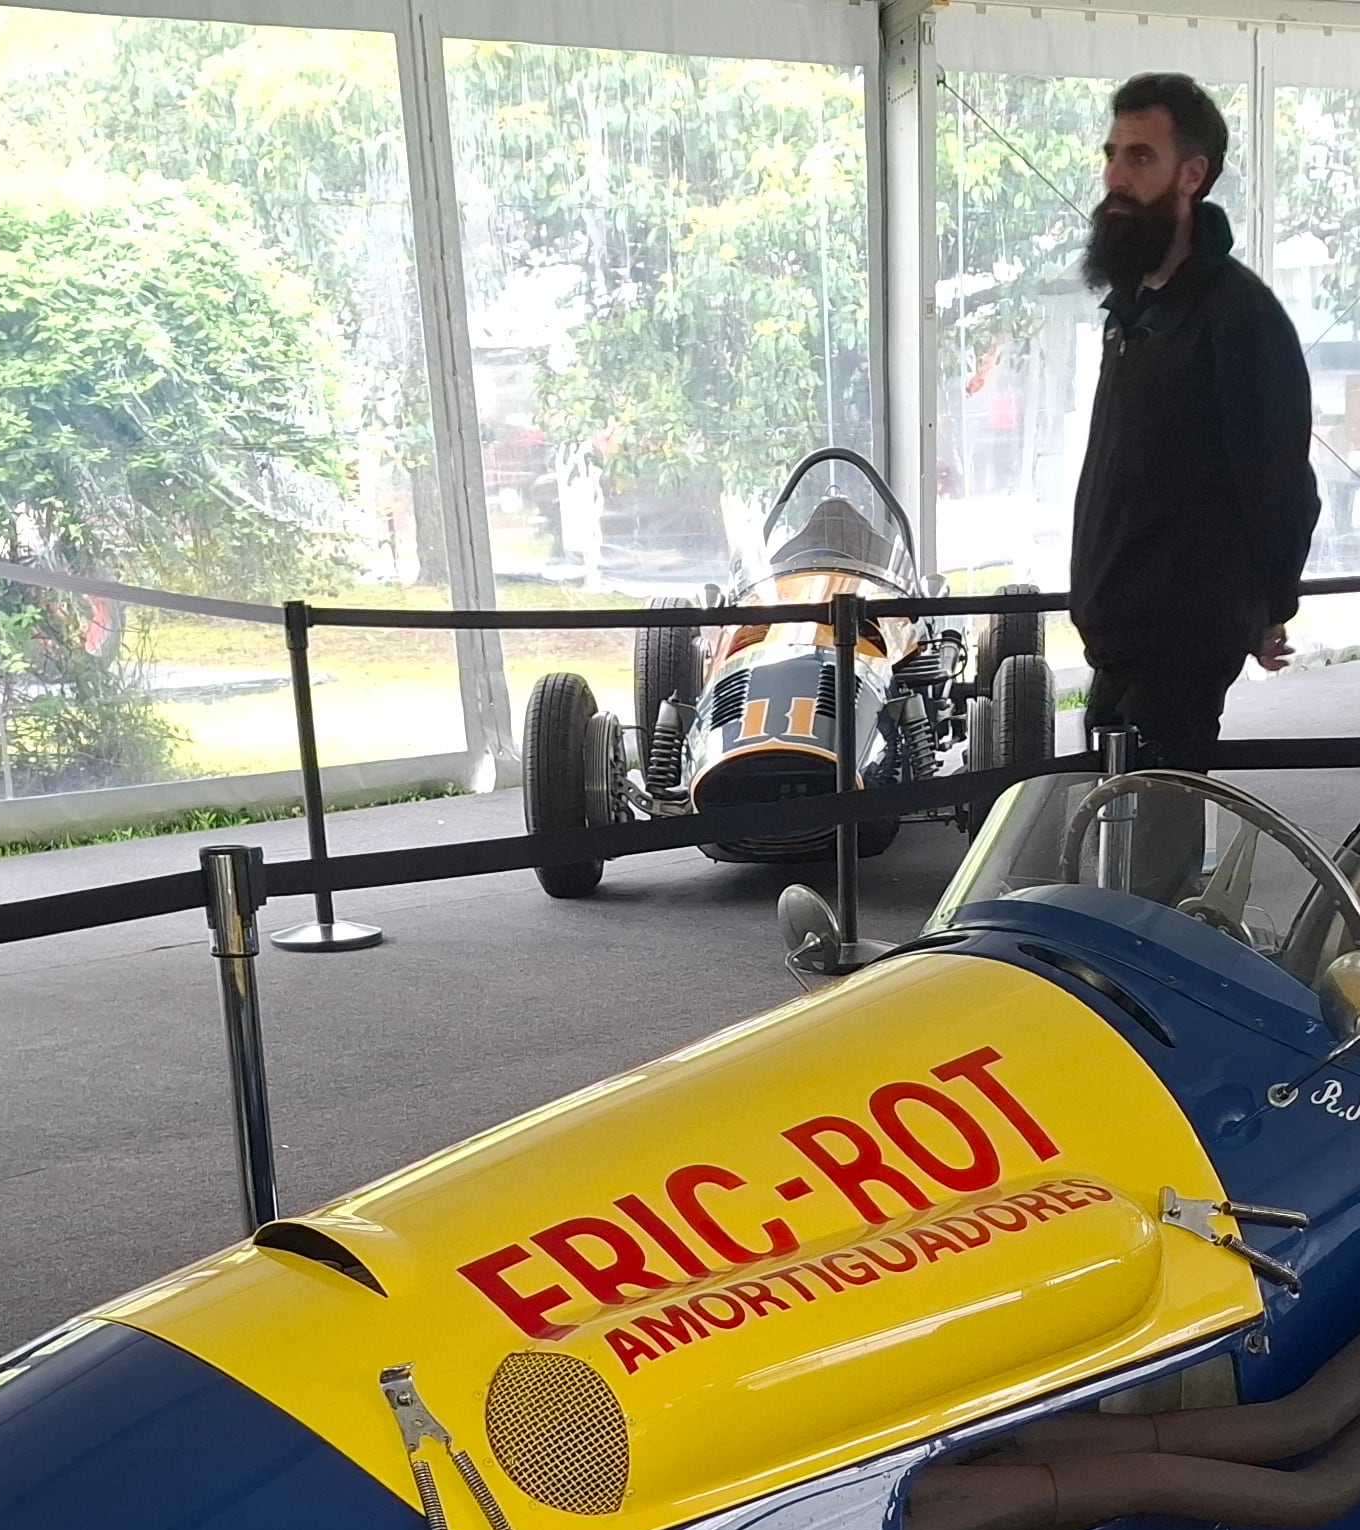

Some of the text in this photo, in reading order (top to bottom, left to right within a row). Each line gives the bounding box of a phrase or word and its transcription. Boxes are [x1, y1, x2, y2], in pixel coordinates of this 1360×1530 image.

[733, 696, 819, 742] 11
[457, 1045, 1061, 1340] ERIC-ROT
[604, 1177, 1115, 1375] AMORTIGUADORES
